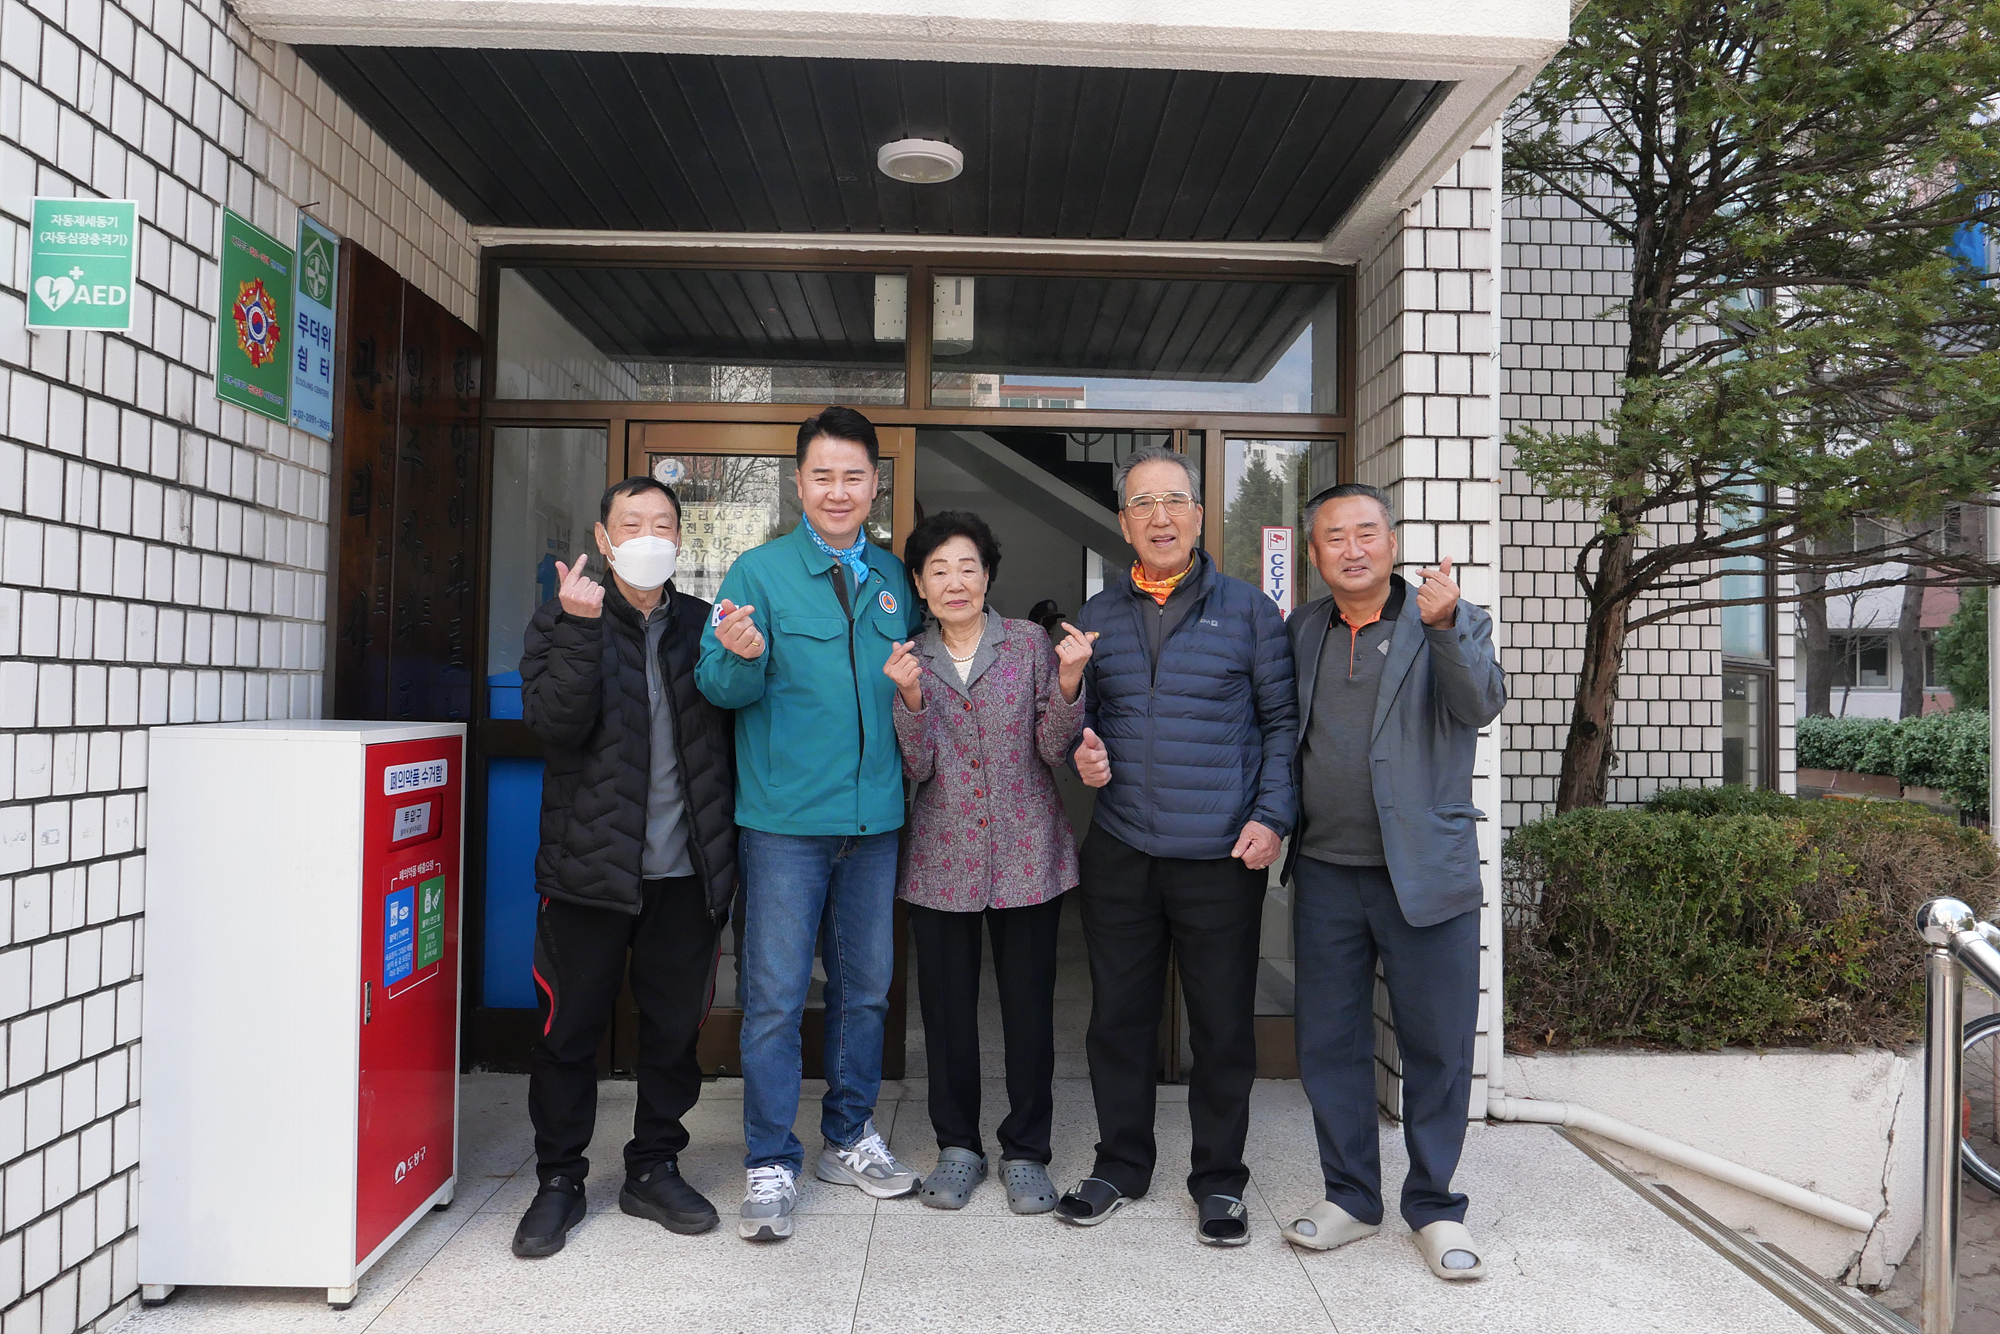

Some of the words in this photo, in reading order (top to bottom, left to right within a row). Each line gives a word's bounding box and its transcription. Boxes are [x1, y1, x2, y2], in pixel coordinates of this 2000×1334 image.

[50, 214, 118, 228] 자동제세동기
[39, 231, 129, 247] (자동심장충격기)
[73, 285, 127, 306] AED
[298, 312, 332, 352] 무더위
[297, 345, 308, 373] 쉼
[320, 357, 330, 384] 터
[1270, 553, 1285, 602] CCTV
[390, 768, 420, 790] 폐의약품
[421, 764, 443, 784] 수거함
[404, 808, 422, 823] 투입구
[407, 1145, 426, 1172] 도봉구
